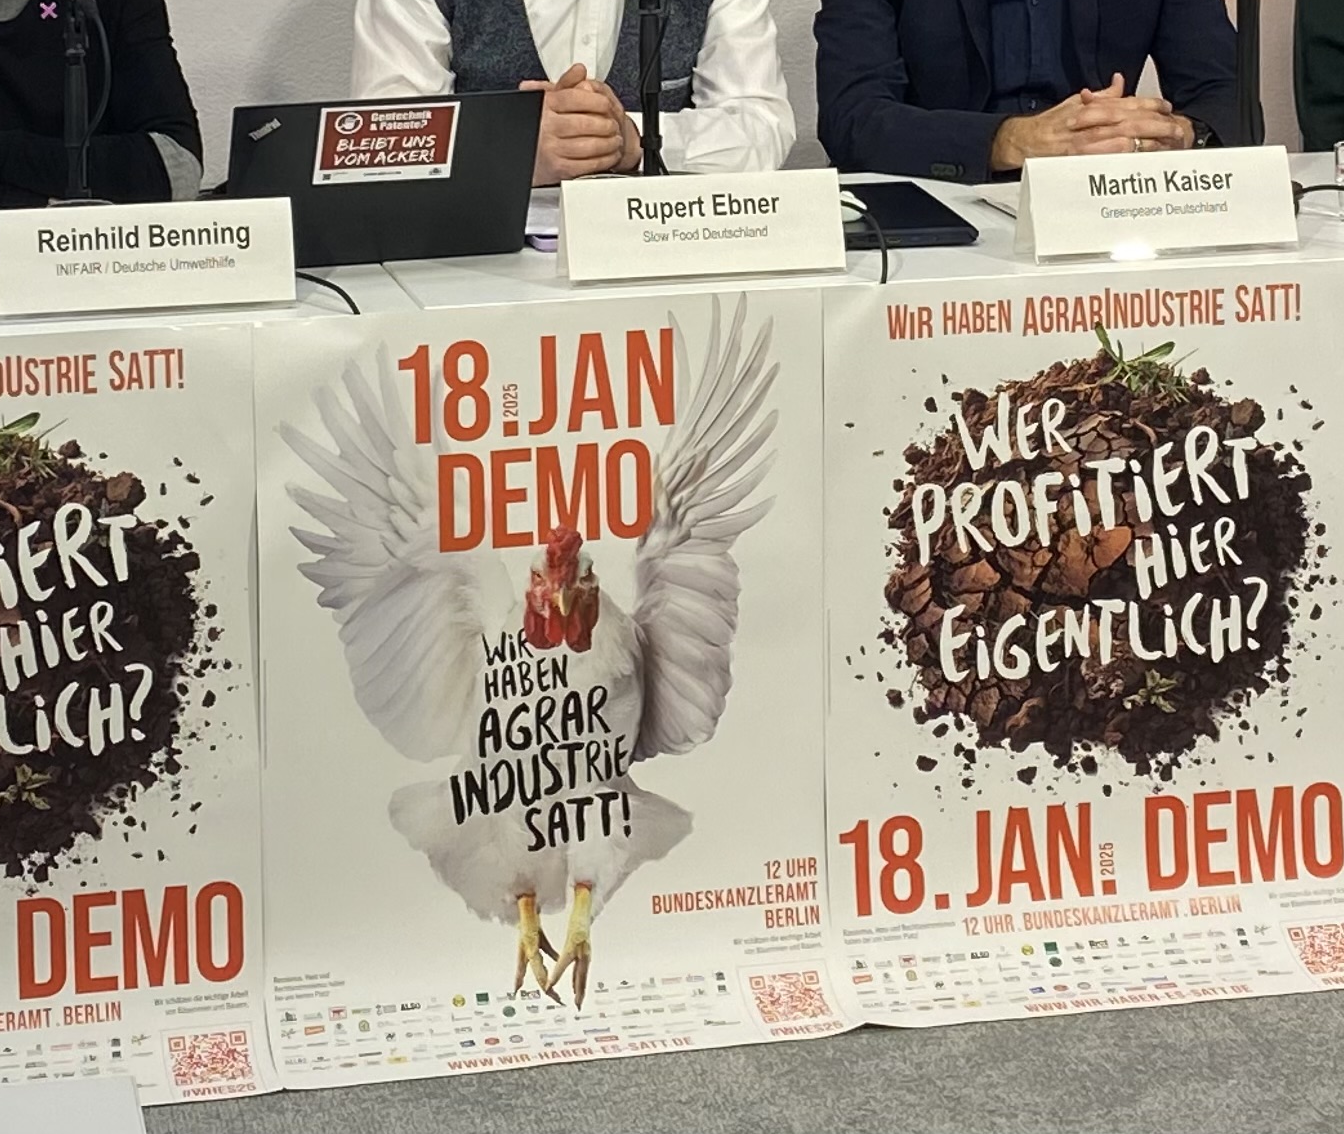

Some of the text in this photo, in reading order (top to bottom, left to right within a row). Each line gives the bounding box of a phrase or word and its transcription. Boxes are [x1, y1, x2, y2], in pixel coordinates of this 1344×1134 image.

[333, 148, 436, 167] VOM ACKER!
[336, 134, 438, 153] BLEIBT UNS
[1088, 169, 1234, 197] Martin Kaiser
[627, 193, 780, 224] Rupert Ebner
[1100, 201, 1228, 220] Greenpeace Deutschland
[37, 221, 251, 254] Reinhild Benning
[643, 225, 769, 243] Slow Food Deutschland
[112, 259, 167, 274] Deutsche
[169, 255, 236, 271] Umwelthilfe
[942, 299, 1012, 336] HABEN
[1235, 283, 1302, 324] SATT!
[109, 348, 185, 391] SATT!
[503, 382, 519, 417] 2025
[956, 392, 1072, 471] WER
[438, 438, 655, 553] DEMO
[484, 654, 568, 704] HABEN
[478, 684, 612, 758] AGRAR
[527, 791, 633, 852] SATT!
[763, 857, 818, 880] 12 UHR
[839, 815, 950, 918] 18.
[1100, 841, 1114, 876] 2025
[651, 881, 819, 915] BUNDESKANZLERAMT
[764, 905, 820, 929] BERLIN
[962, 917, 980, 937] 12
[1189, 894, 1243, 916] BERLIN
[16, 881, 245, 1000] DEMO
[63, 1000, 123, 1026] BERLIN
